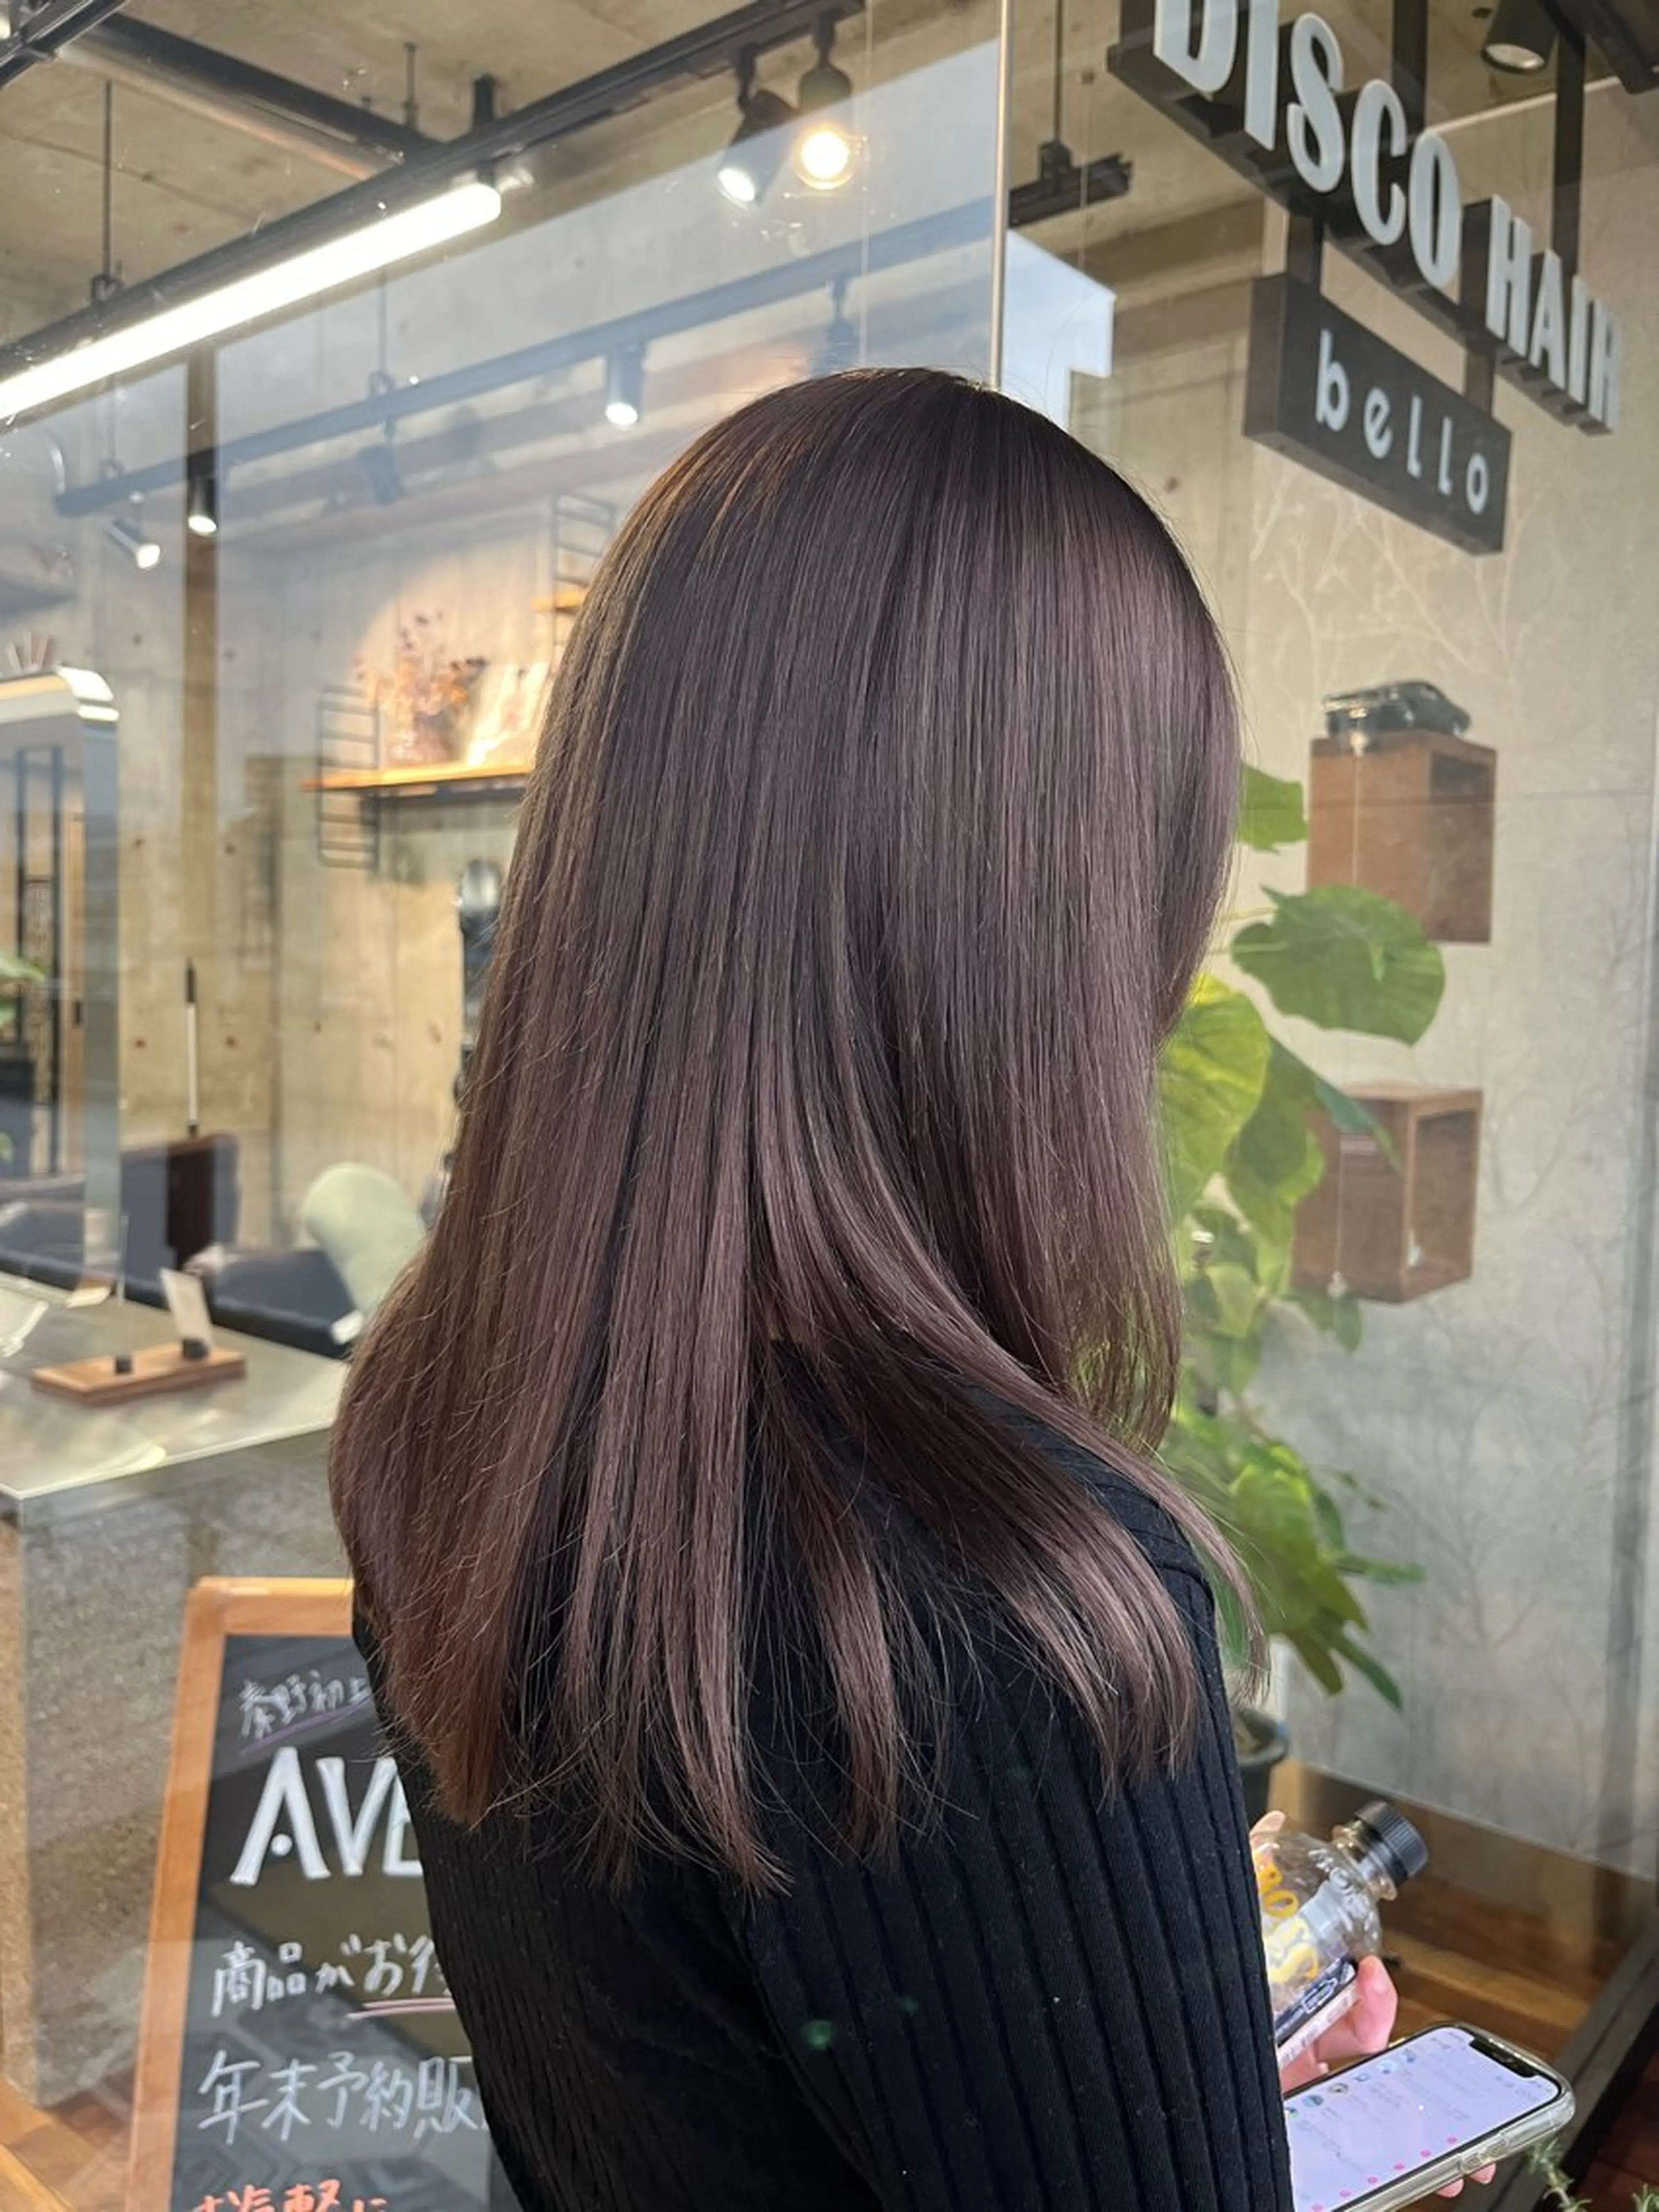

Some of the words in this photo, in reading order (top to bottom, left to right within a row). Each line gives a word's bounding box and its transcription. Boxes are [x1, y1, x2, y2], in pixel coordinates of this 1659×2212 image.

[1486, 194, 1621, 432] HAIR
[1316, 329, 1489, 515] bello
[198, 2050, 489, 2145] 年末予約販
